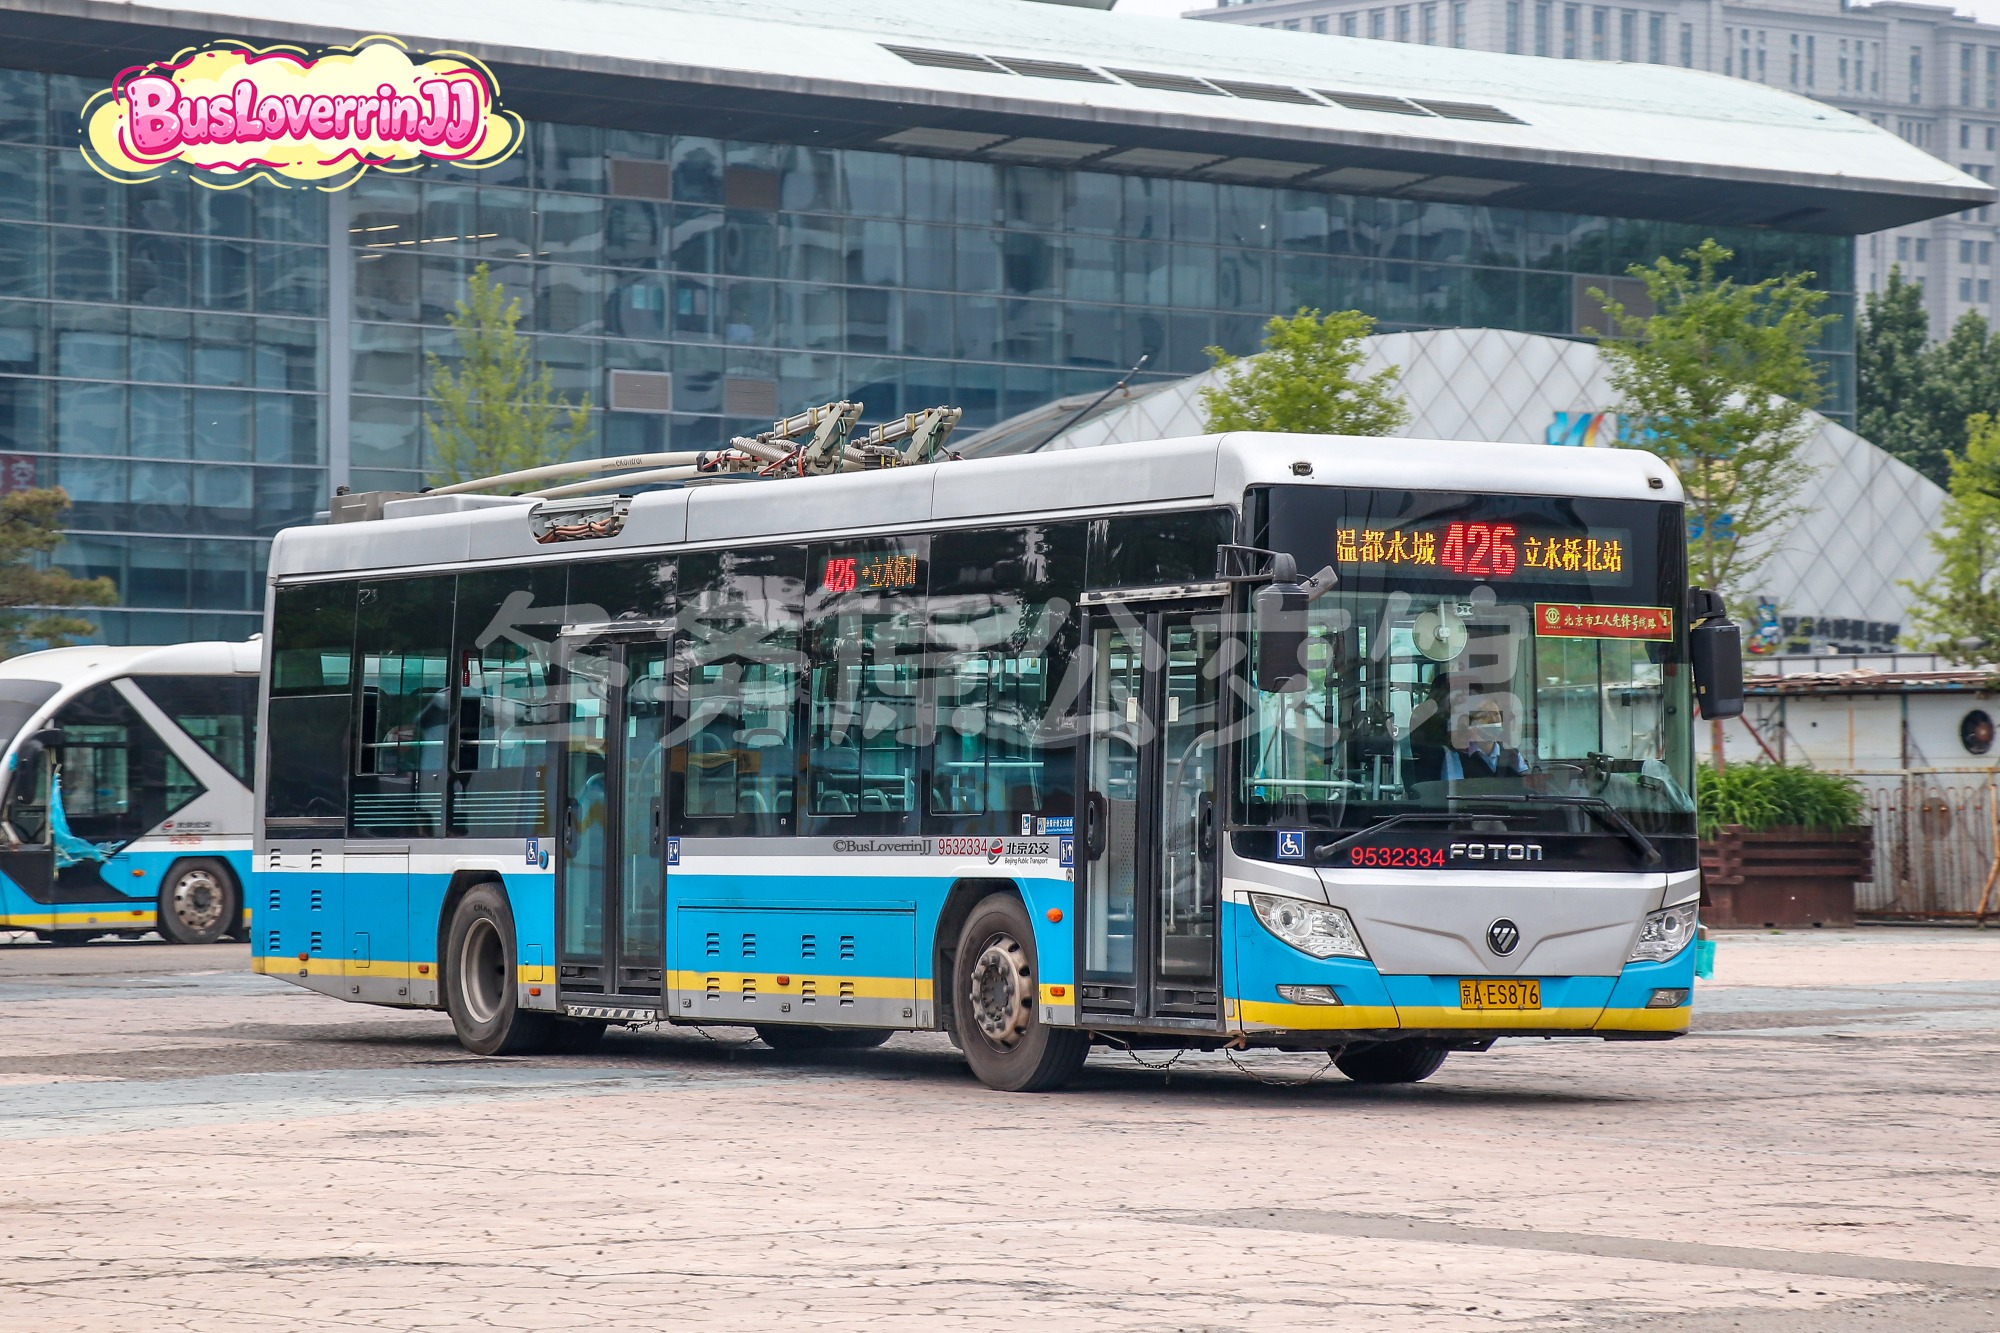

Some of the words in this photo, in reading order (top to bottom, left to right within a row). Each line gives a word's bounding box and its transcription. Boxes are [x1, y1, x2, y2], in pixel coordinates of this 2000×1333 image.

[1336, 528, 1437, 565] 温都水城
[1441, 522, 1516, 575] 426
[1523, 536, 1622, 572] 立水桥北站
[823, 557, 857, 592] 426
[1564, 612, 1657, 631] 北京市工人先锋号线路
[938, 838, 988, 855] 9532334
[1005, 842, 1049, 854] 北京公交
[1004, 857, 1018, 866] Beijing
[1029, 857, 1048, 866] Transport
[1351, 847, 1445, 867] 9532334
